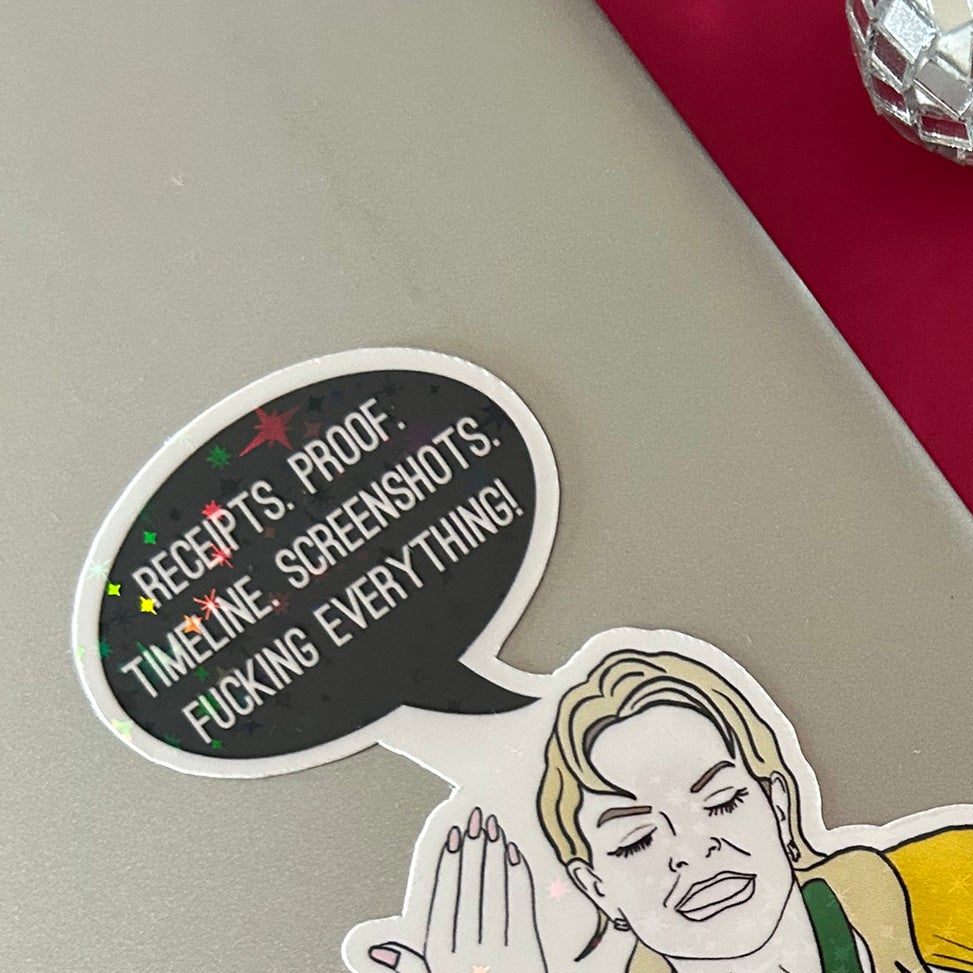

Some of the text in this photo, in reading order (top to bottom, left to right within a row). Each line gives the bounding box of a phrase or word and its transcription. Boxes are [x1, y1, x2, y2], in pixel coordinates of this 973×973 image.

[121, 415, 502, 699] TIMELINE. SCREENSHOTS.
[131, 398, 407, 609] RECEIPTS. PROOF.
[181, 478, 525, 745] FUCKING EVERYTHING!
